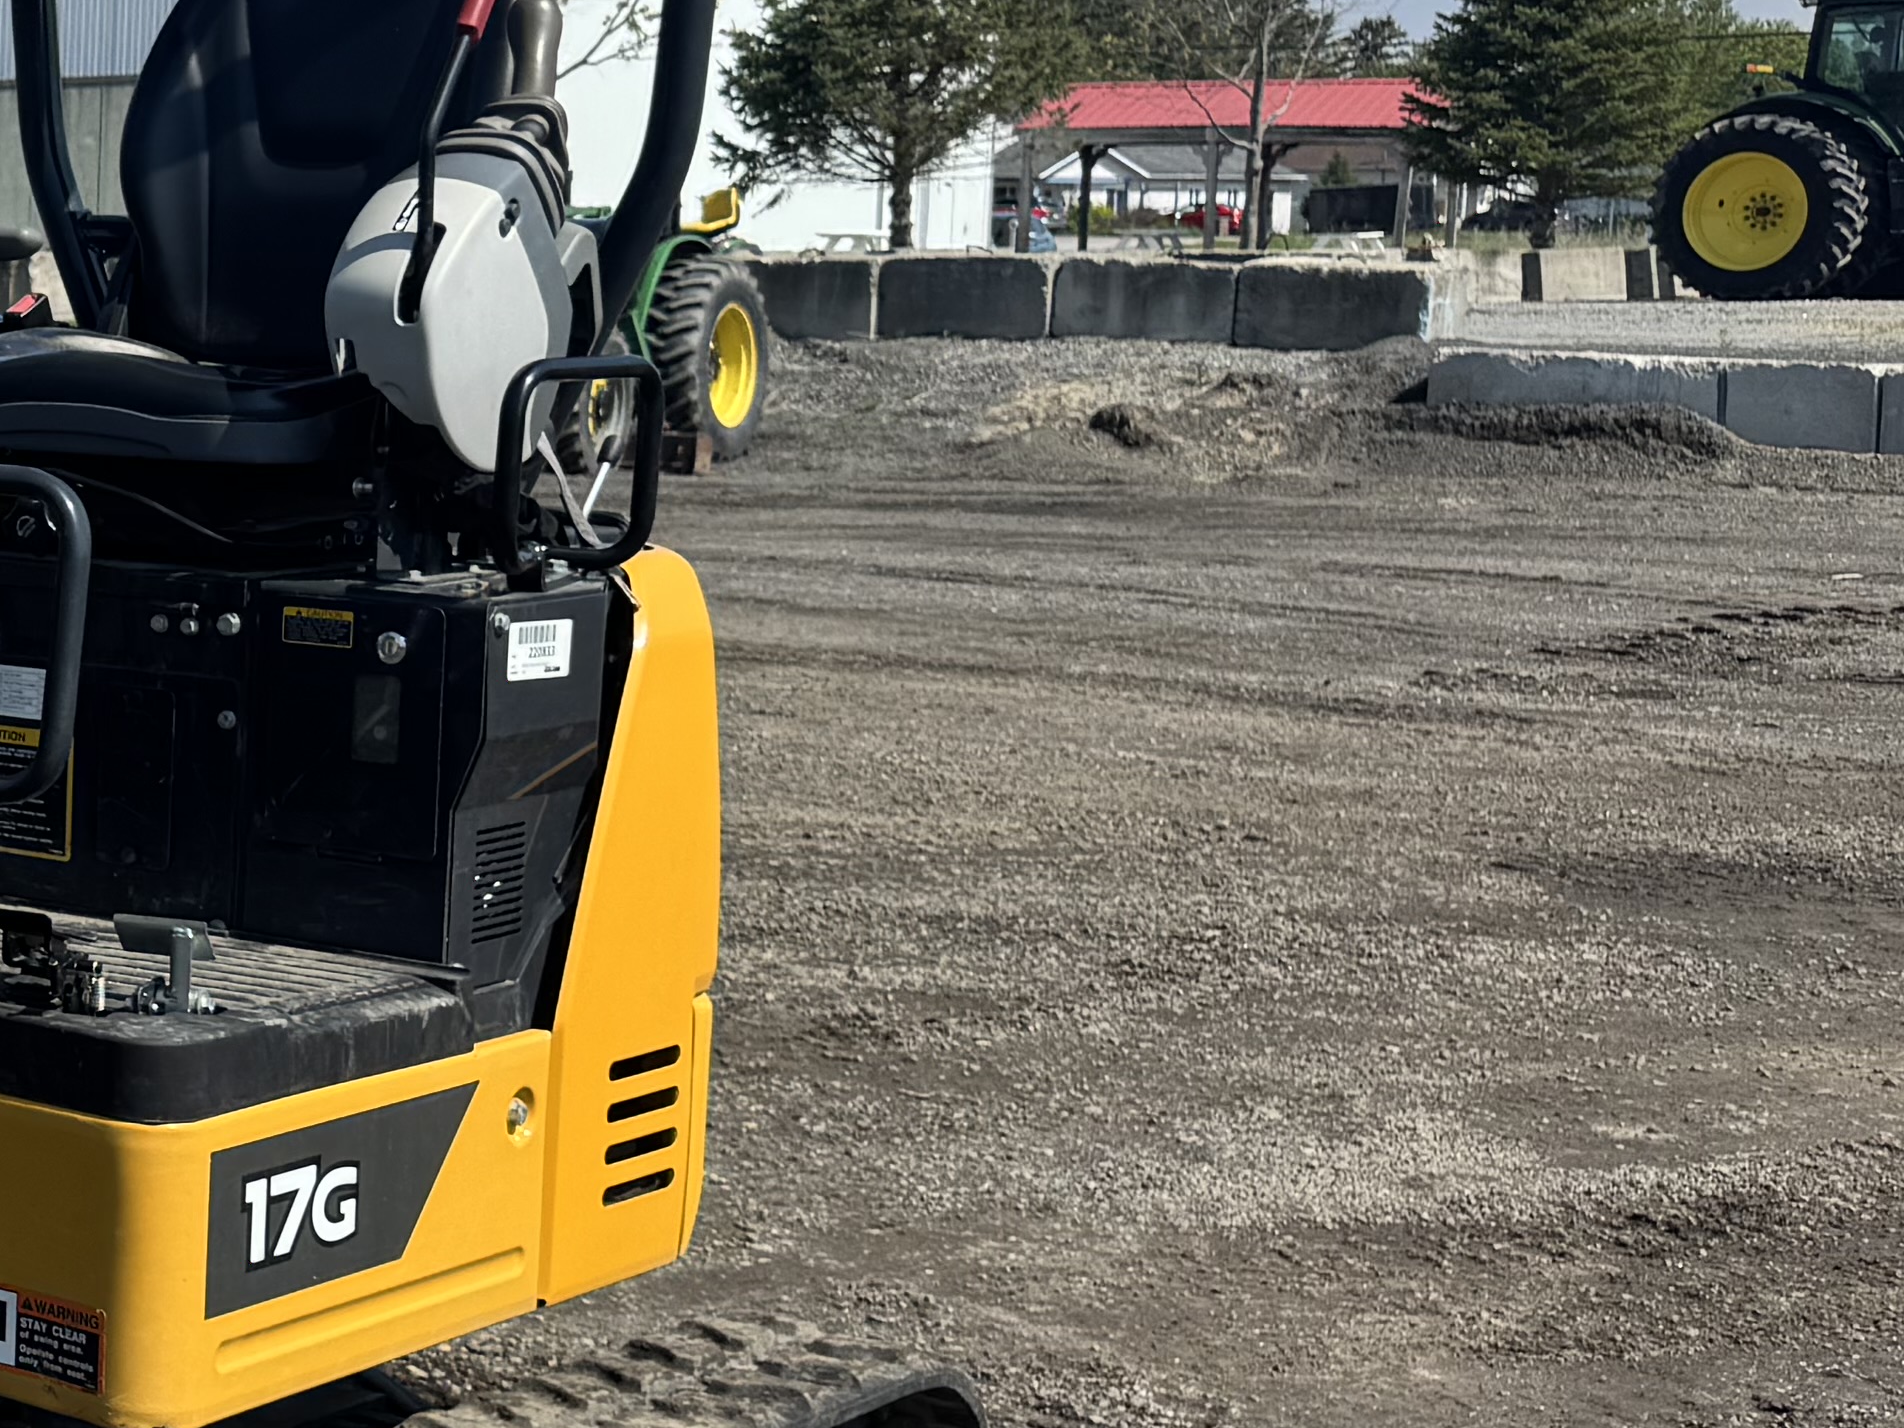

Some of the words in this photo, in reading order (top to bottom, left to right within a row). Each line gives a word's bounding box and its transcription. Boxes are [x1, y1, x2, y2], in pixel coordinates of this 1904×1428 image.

[245, 1163, 358, 1264] 17G
[34, 1299, 99, 1329] WARNING
[20, 1317, 48, 1333] STAY
[51, 1325, 87, 1345] CLEAR
